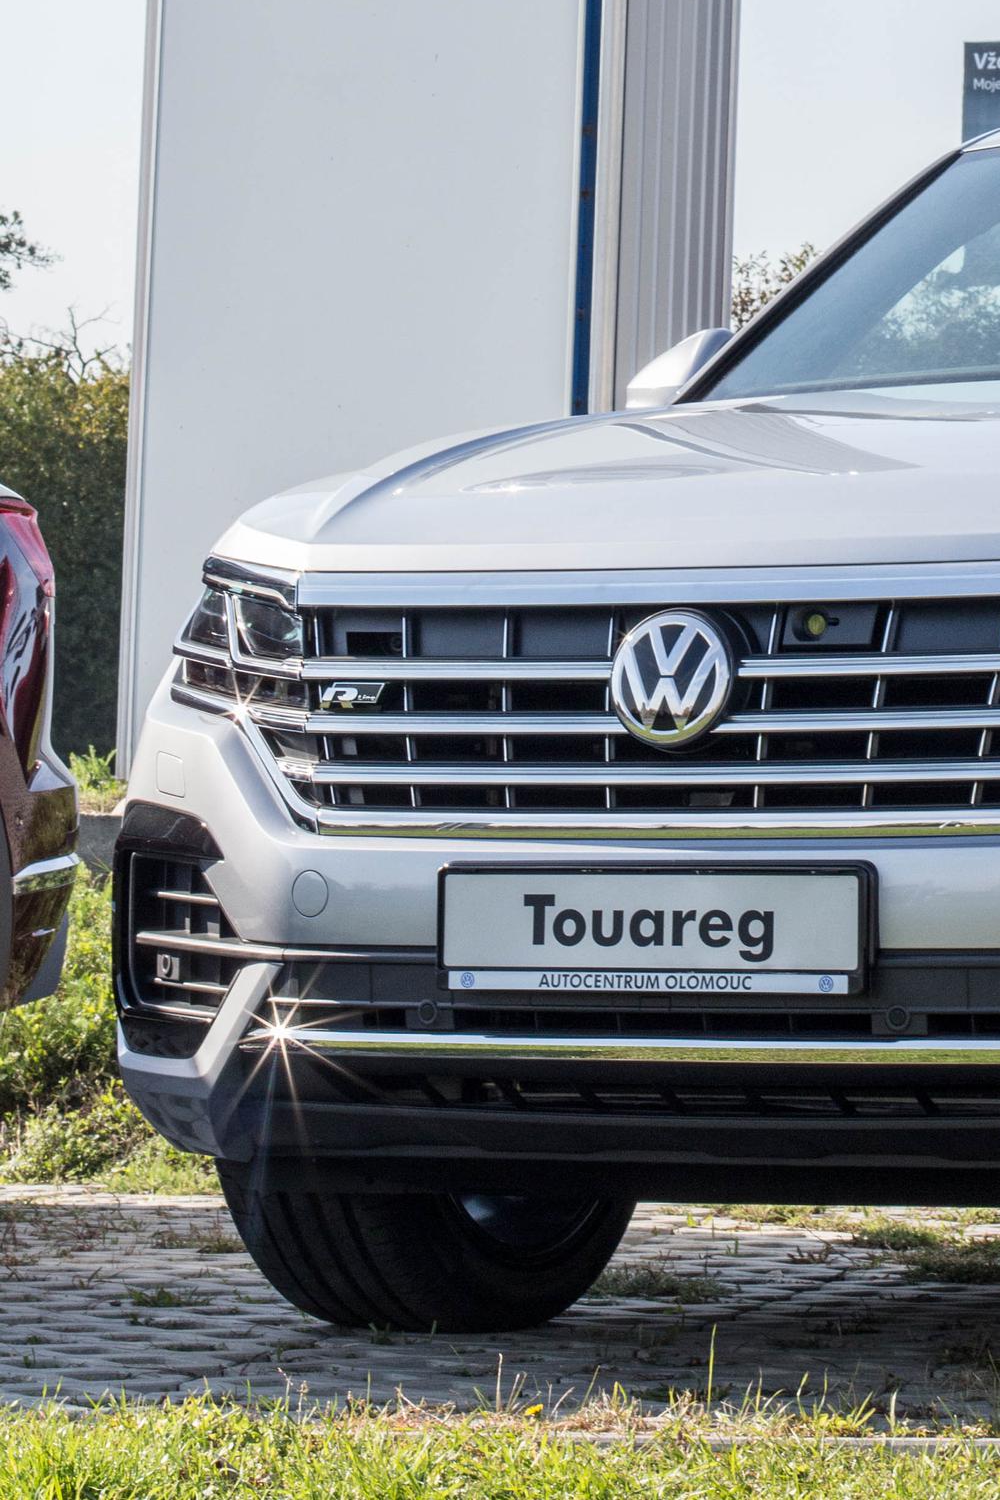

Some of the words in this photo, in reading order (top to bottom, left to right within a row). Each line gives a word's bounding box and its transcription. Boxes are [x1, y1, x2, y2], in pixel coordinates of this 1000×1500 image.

[320, 687, 358, 709] R
[523, 893, 775, 963] Touareg
[538, 973, 660, 990] AUTOCENTRUM
[664, 974, 752, 991] OLOMOUC
